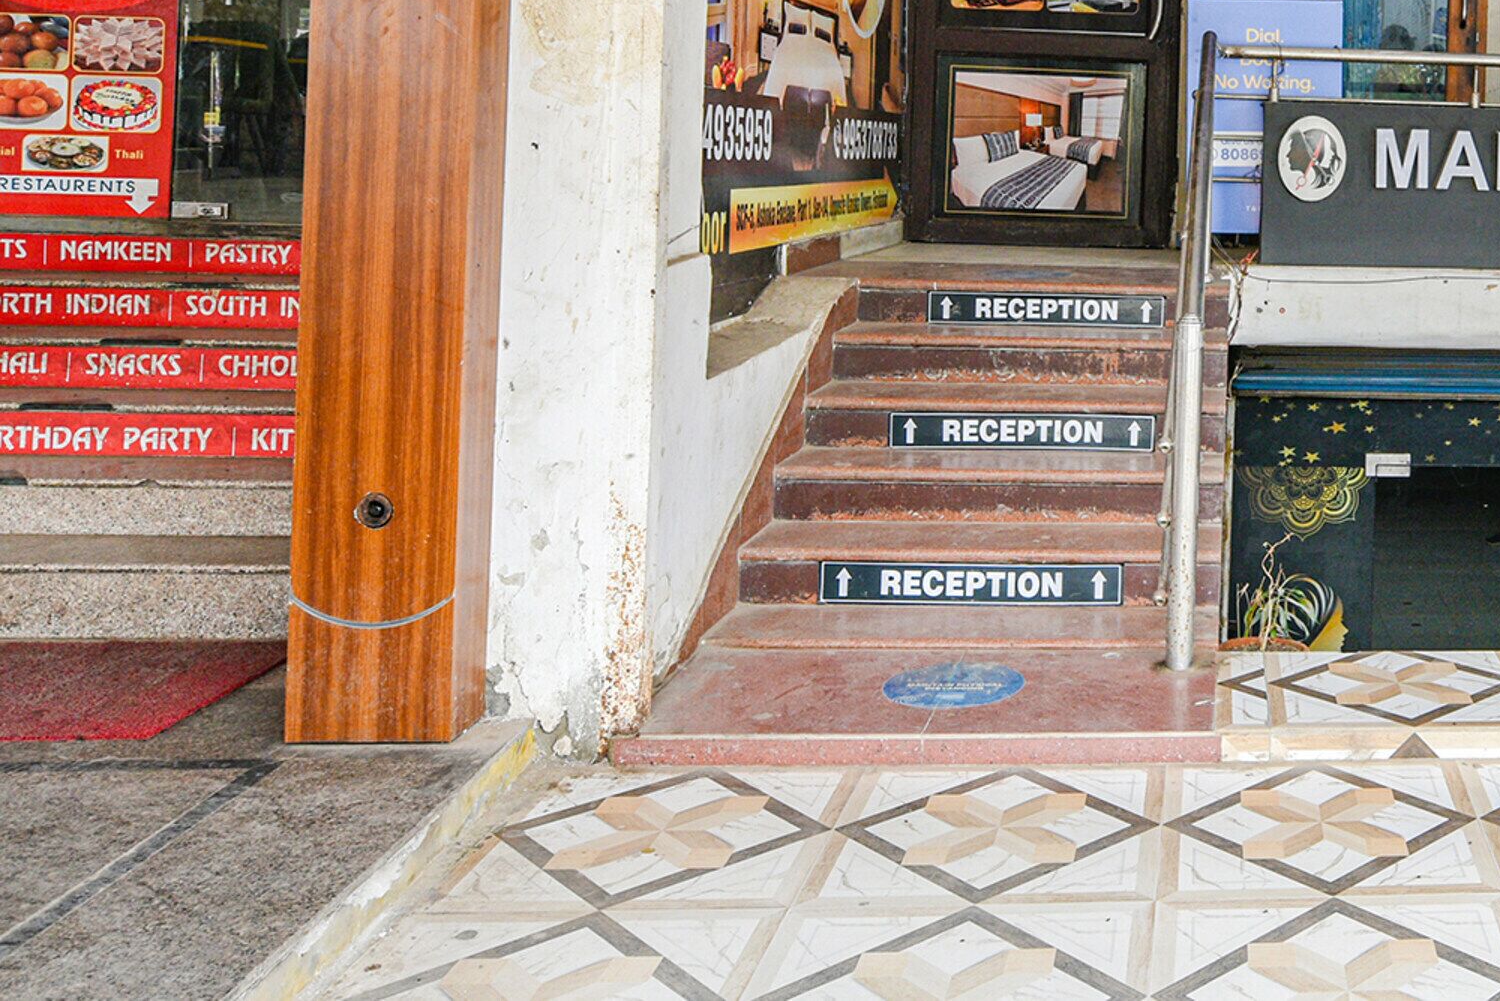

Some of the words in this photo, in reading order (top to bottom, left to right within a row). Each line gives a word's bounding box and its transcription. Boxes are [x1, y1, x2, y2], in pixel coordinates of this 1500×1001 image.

[1246, 27, 1284, 43] Dial.
[1215, 74, 1239, 89] No
[1243, 74, 1316, 93] Wating.
[702, 104, 773, 161] 4935959
[115, 149, 144, 160] Thali
[0, 238, 27, 258] TS
[60, 240, 172, 262] NAMKEEN
[205, 243, 292, 265] PASTRY
[0, 292, 52, 315] RTH
[66, 293, 151, 316] INDIAN
[186, 295, 266, 317] SOUTH
[974, 297, 1119, 321] RECEPTION
[85, 353, 182, 376] SNACKS
[124, 427, 213, 452] PARTY
[251, 428, 295, 452] KIT
[942, 419, 1104, 444] RECEPTION
[880, 569, 1064, 598] RECEPTION
